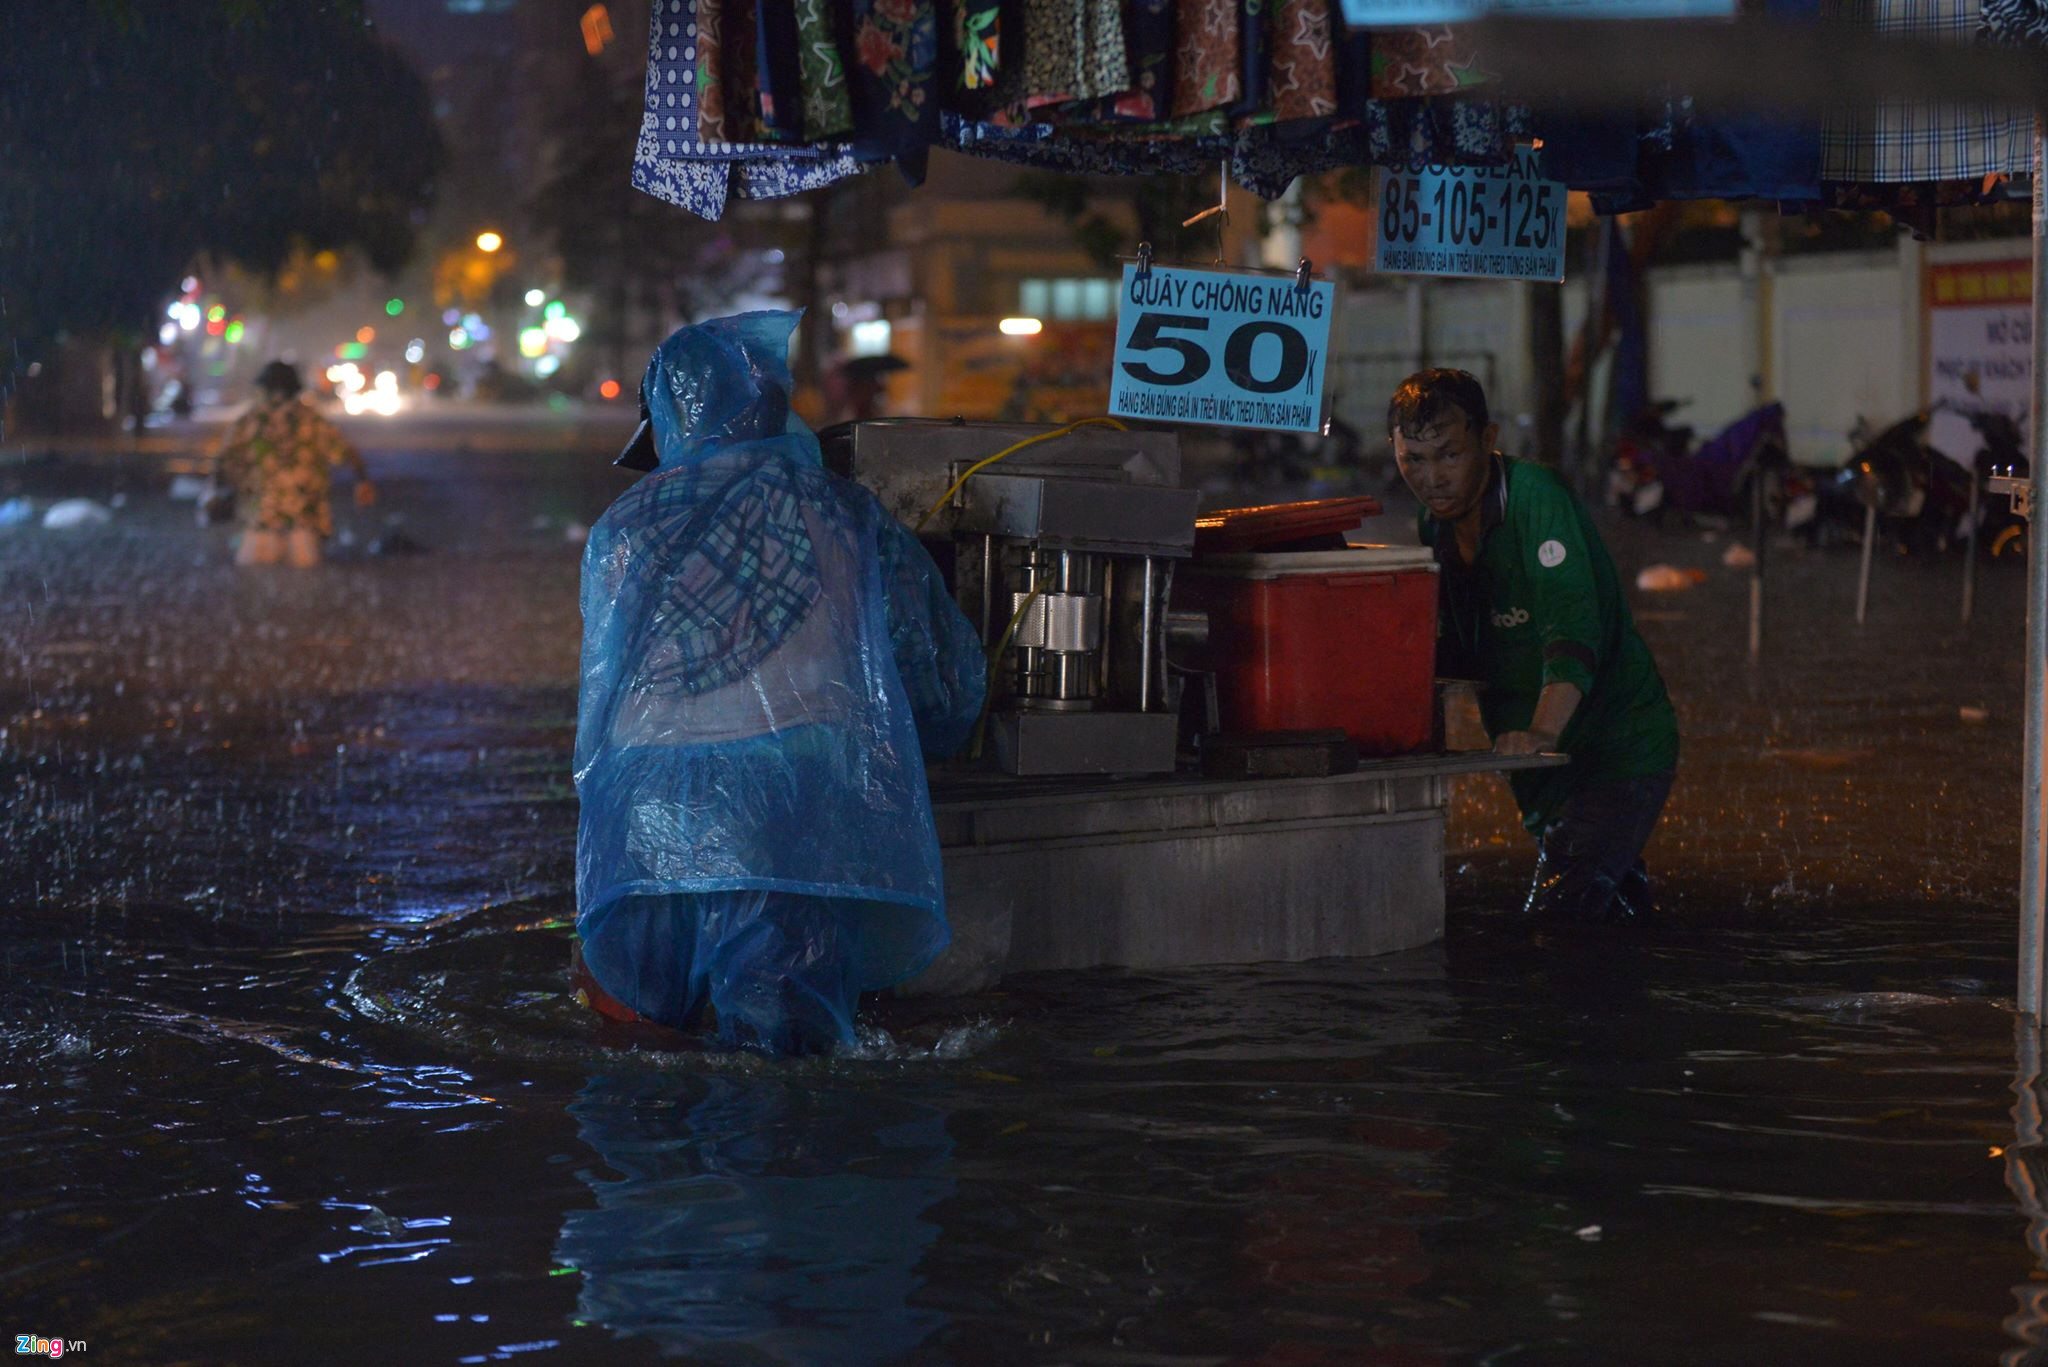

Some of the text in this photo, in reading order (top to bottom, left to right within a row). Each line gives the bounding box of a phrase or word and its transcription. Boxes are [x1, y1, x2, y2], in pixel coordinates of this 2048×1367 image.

[1118, 386, 1139, 413] HÀNG
[1140, 388, 1157, 415] BÁN
[1156, 389, 1177, 417] ĐÚNG
[1177, 391, 1191, 418] GIÁ
[1190, 397, 1199, 418] IN
[1200, 392, 1219, 420] TRÊN
[1236, 400, 1255, 423] THEO
